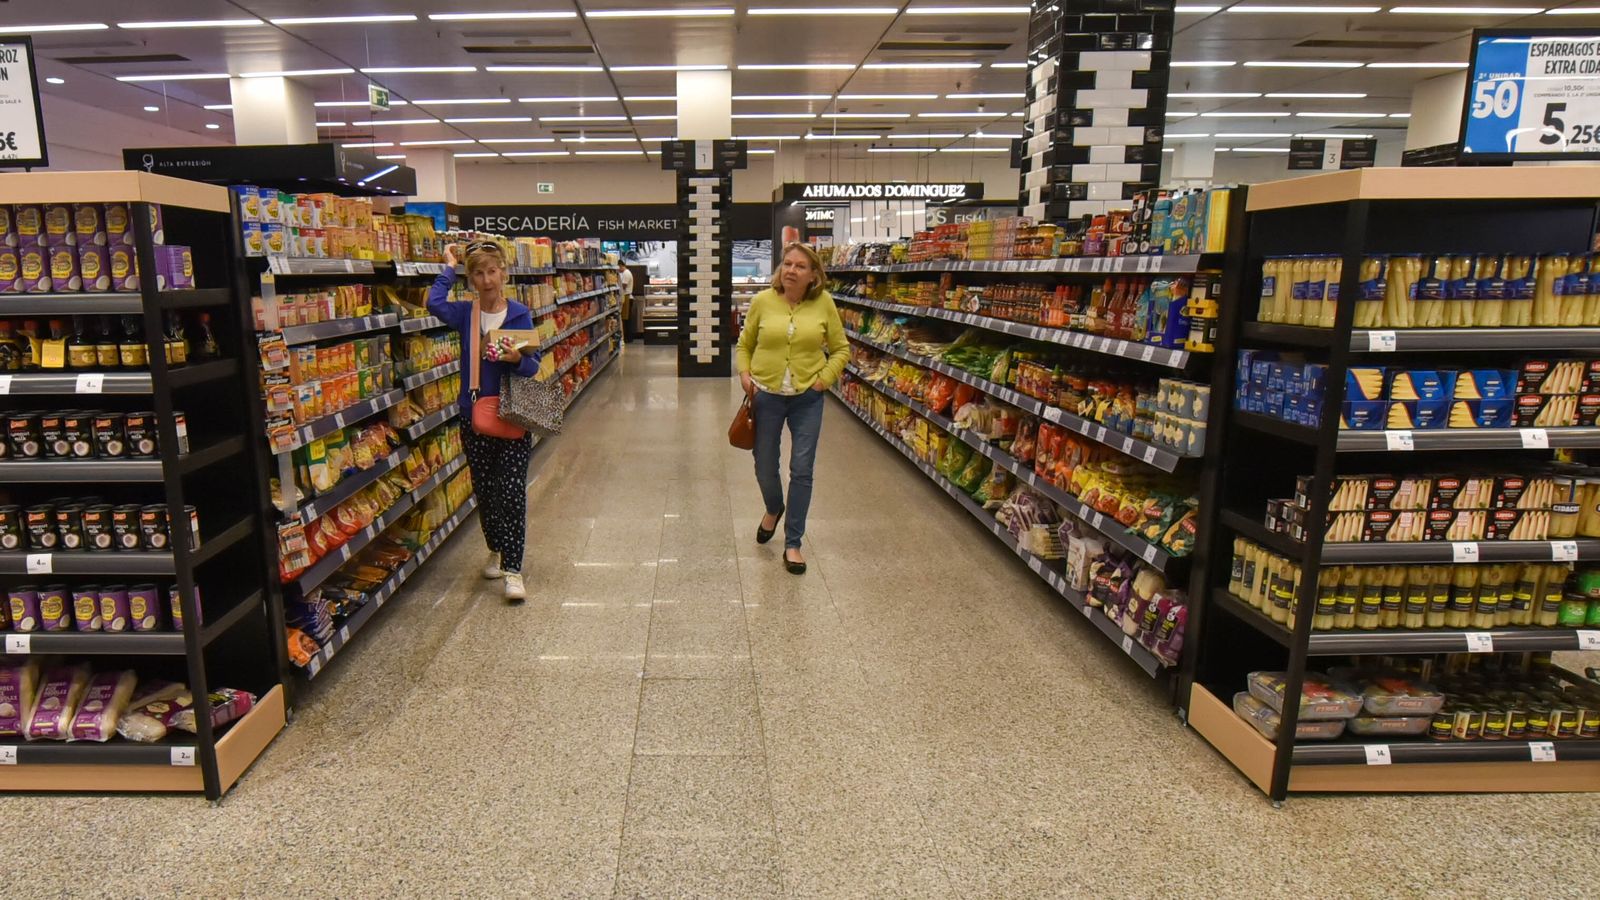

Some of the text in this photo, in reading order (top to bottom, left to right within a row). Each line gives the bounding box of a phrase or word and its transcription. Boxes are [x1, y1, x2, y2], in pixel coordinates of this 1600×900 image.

[1530, 41, 1593, 57] ESPÁRRAGOS
[1544, 60, 1577, 74] EXTRA
[702, 153, 706, 164] 1
[1328, 153, 1336, 164] 3
[802, 184, 966, 198] AHUMADOS DOMINGUEZ
[474, 213, 677, 232] PESCADERÍA FISH MARKET
